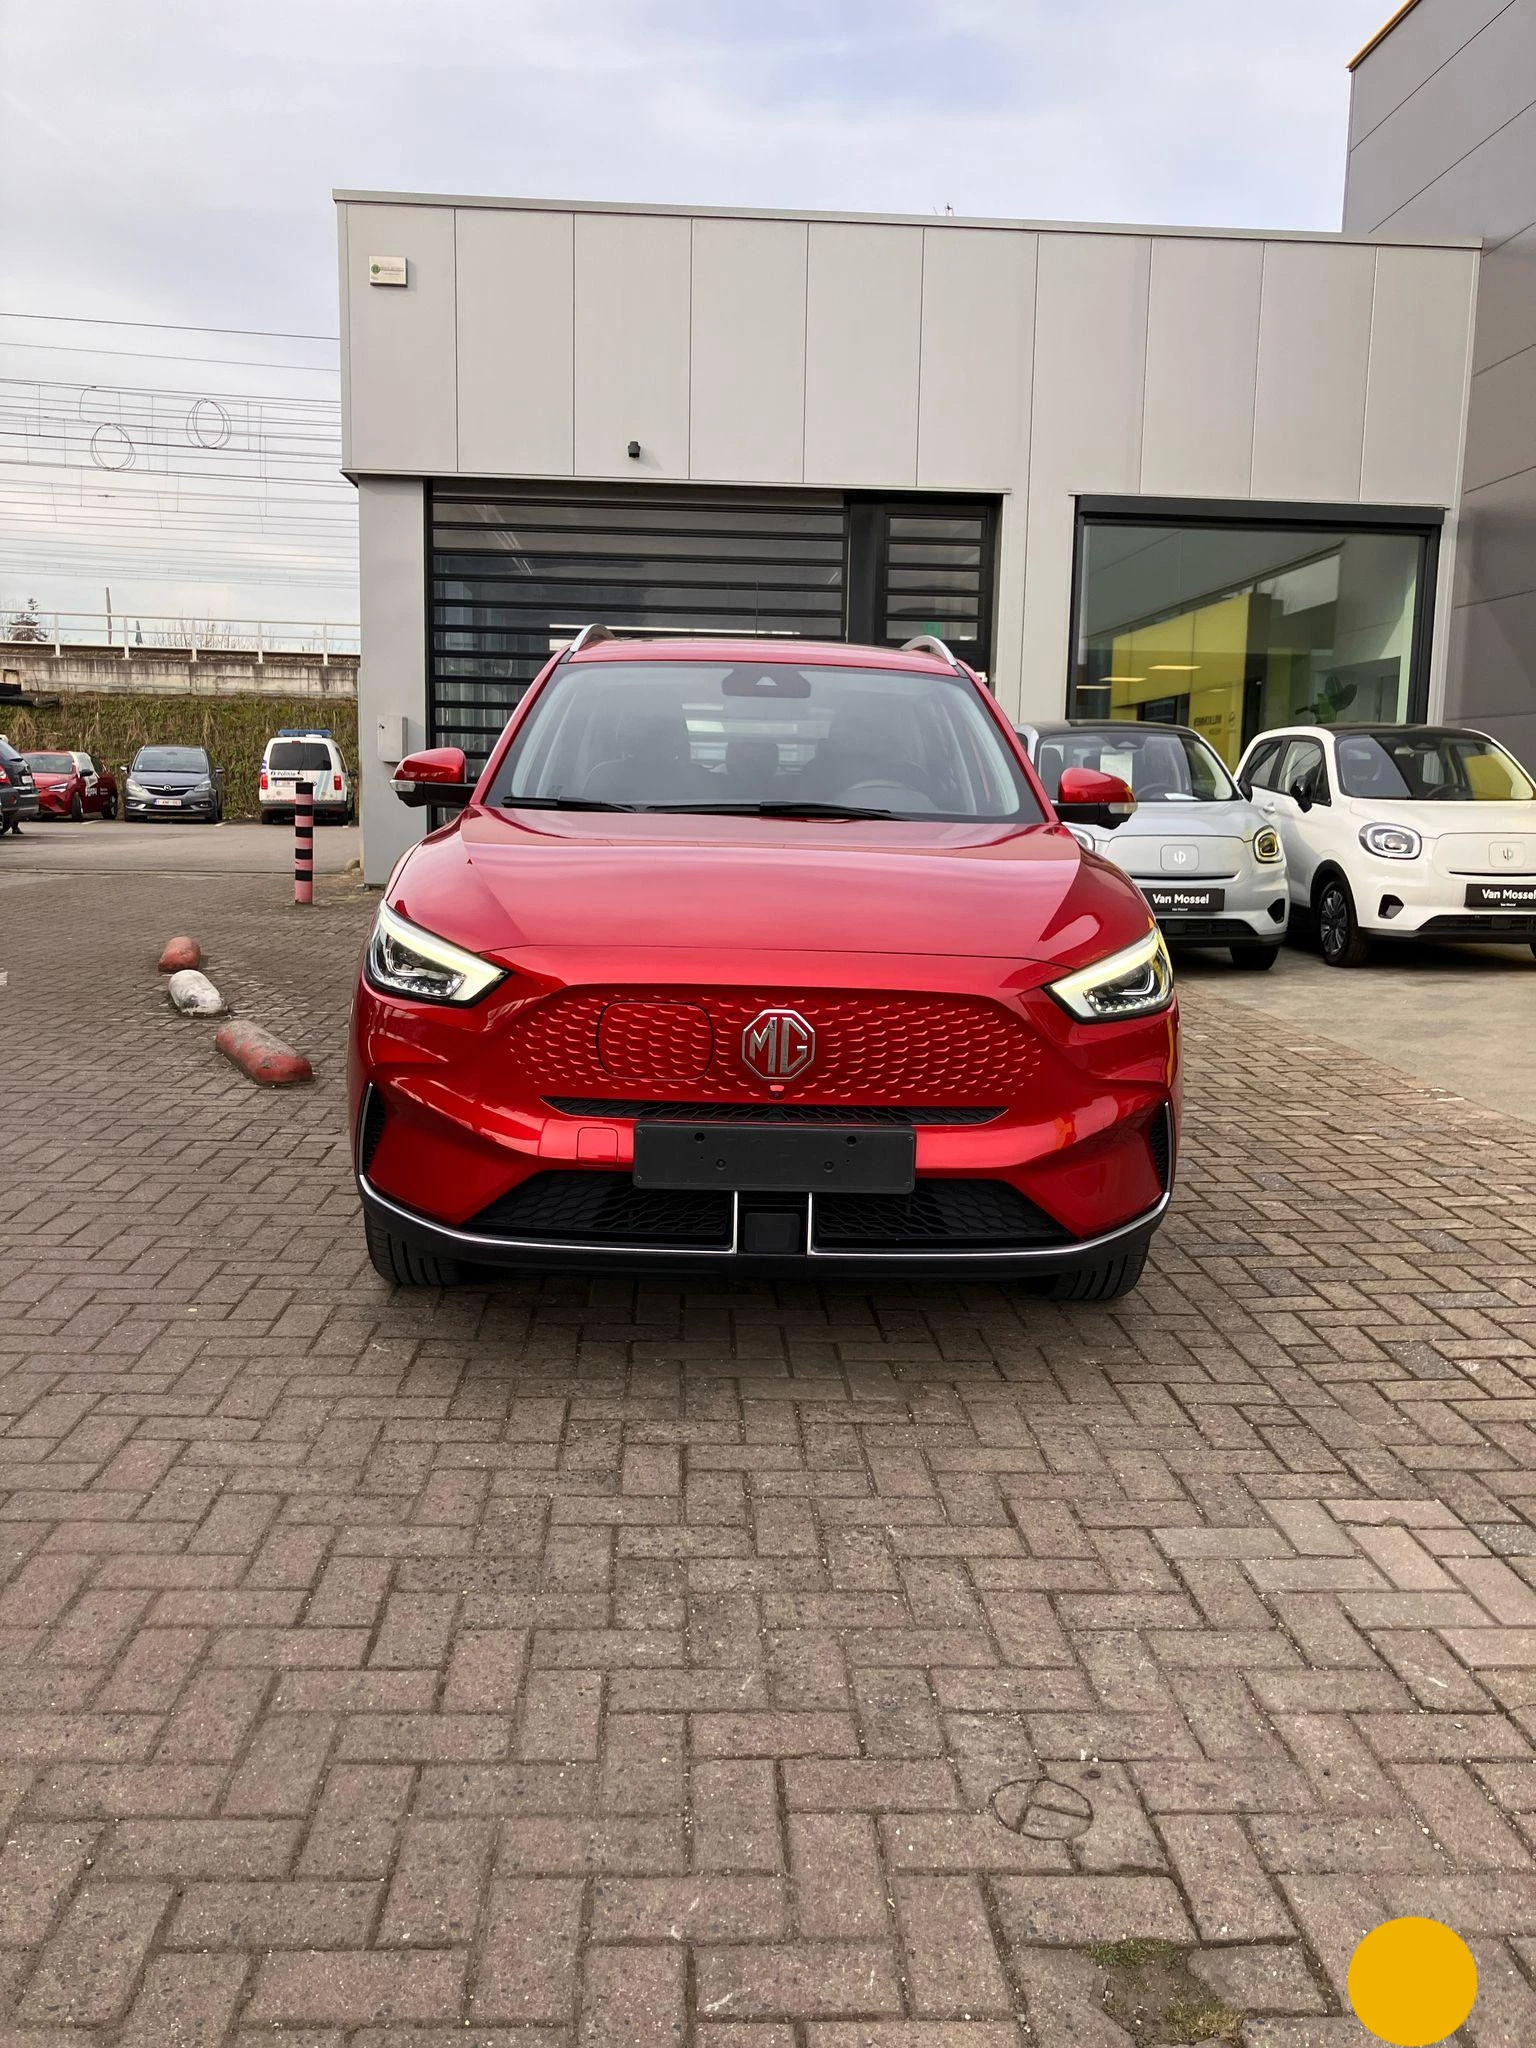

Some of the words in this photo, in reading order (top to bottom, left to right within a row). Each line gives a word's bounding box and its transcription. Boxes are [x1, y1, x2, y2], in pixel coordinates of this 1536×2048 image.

[1152, 893, 1171, 904] Van
[1174, 893, 1210, 904] Mossel
[1482, 888, 1501, 899] Van
[748, 1016, 808, 1075] MG
